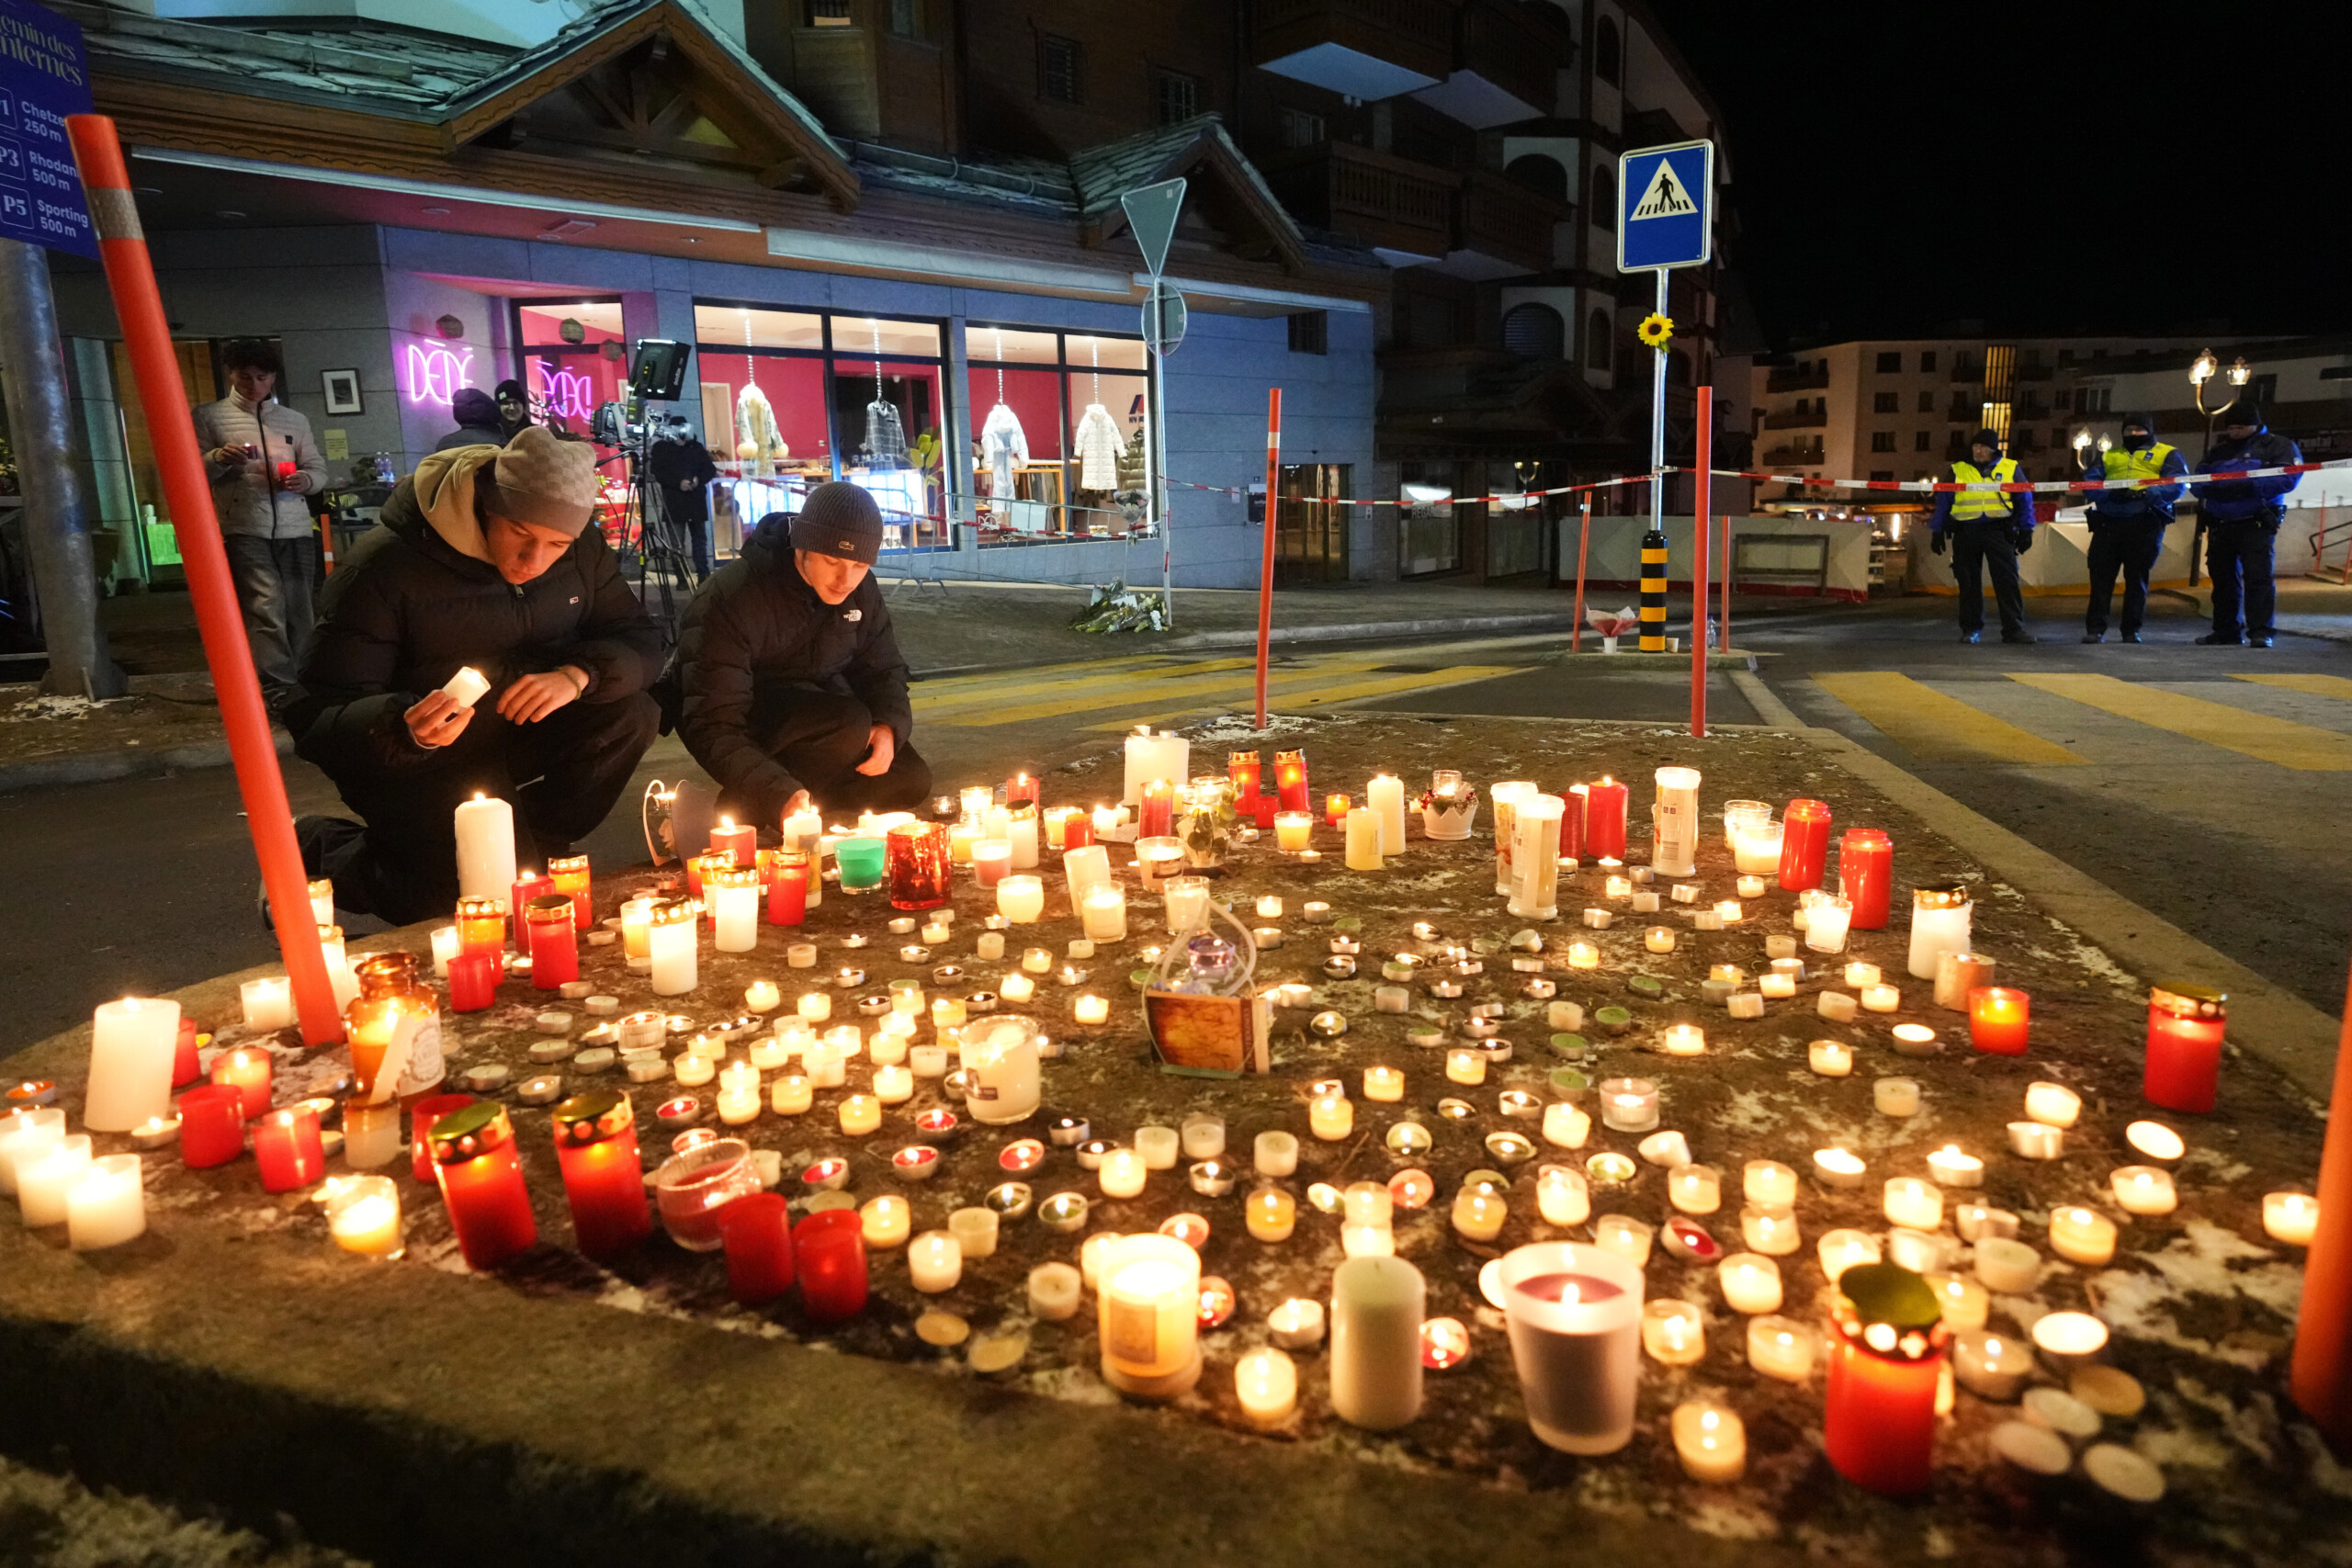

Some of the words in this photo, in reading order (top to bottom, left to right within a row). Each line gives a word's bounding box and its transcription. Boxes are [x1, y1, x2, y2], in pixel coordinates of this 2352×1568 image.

[0, 16, 46, 48] emin
[48, 35, 76, 62] des
[0, 35, 83, 86] nternes
[0, 99, 10, 116] 1
[21, 101, 65, 127] Chetze
[24, 118, 48, 137] 250
[50, 130, 62, 142] m
[29, 150, 78, 177] Rhodan
[32, 168, 56, 186] 500
[58, 179, 70, 191] m
[4, 195, 27, 216] P5
[37, 198, 89, 229] Sporting
[40, 216, 62, 233] 500
[64, 226, 76, 237] m
